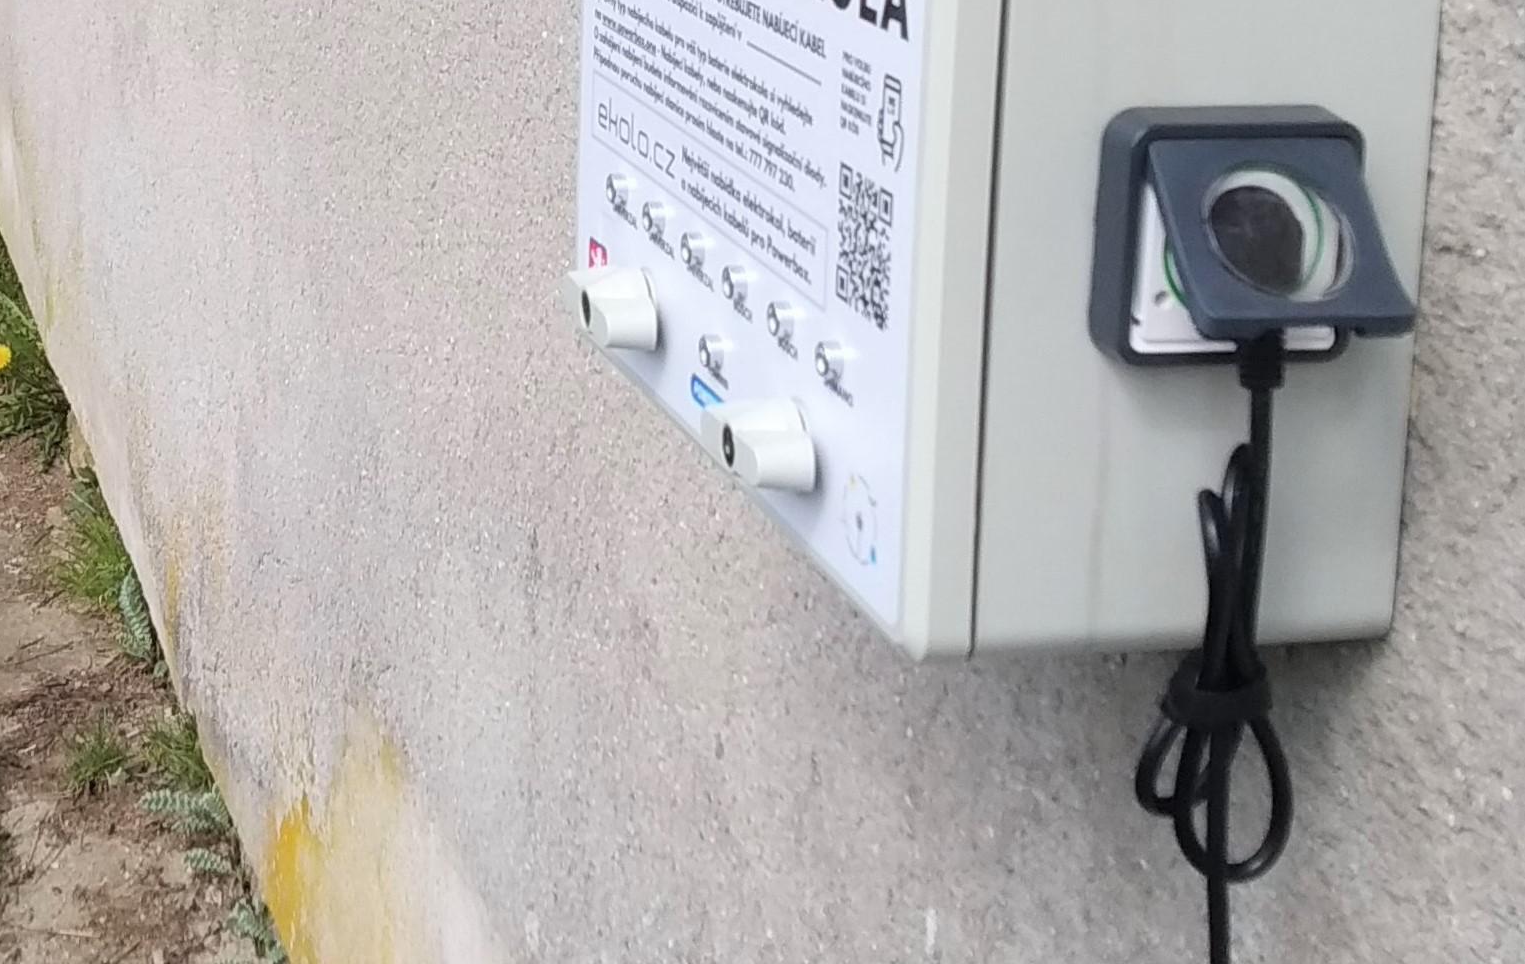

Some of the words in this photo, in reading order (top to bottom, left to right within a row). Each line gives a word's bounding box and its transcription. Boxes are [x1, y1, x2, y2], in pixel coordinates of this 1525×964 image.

[761, 8, 798, 43] NABÍJECÍ
[798, 27, 826, 59] KABEL
[597, 97, 675, 179] ekolo.cz
[748, 147, 762, 169] 777
